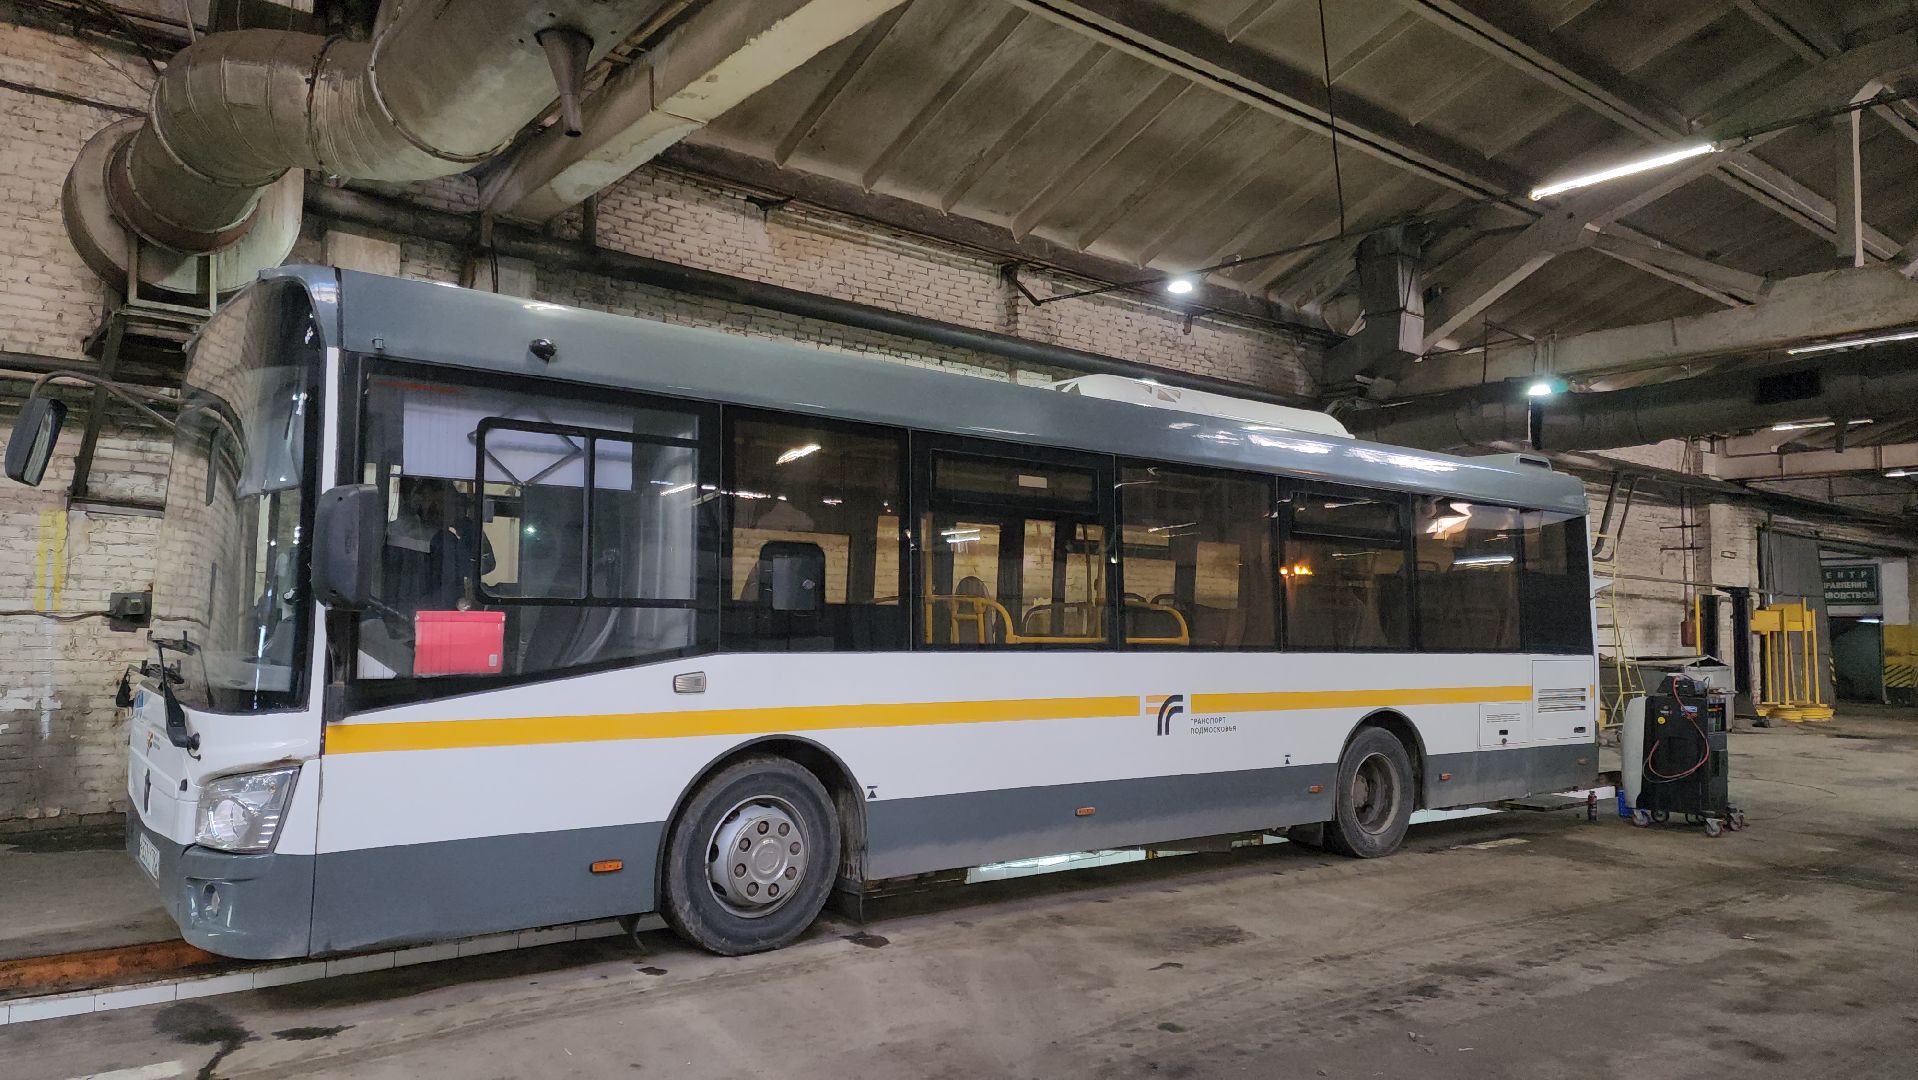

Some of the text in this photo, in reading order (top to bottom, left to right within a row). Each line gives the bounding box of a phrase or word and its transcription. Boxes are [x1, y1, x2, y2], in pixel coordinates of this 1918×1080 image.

[1825, 571, 1868, 579] ЕНТР
[1823, 581, 1868, 589] РАВЛЕНИЯ
[1190, 725, 1237, 735] ПОДМОСКОВЬЯ
